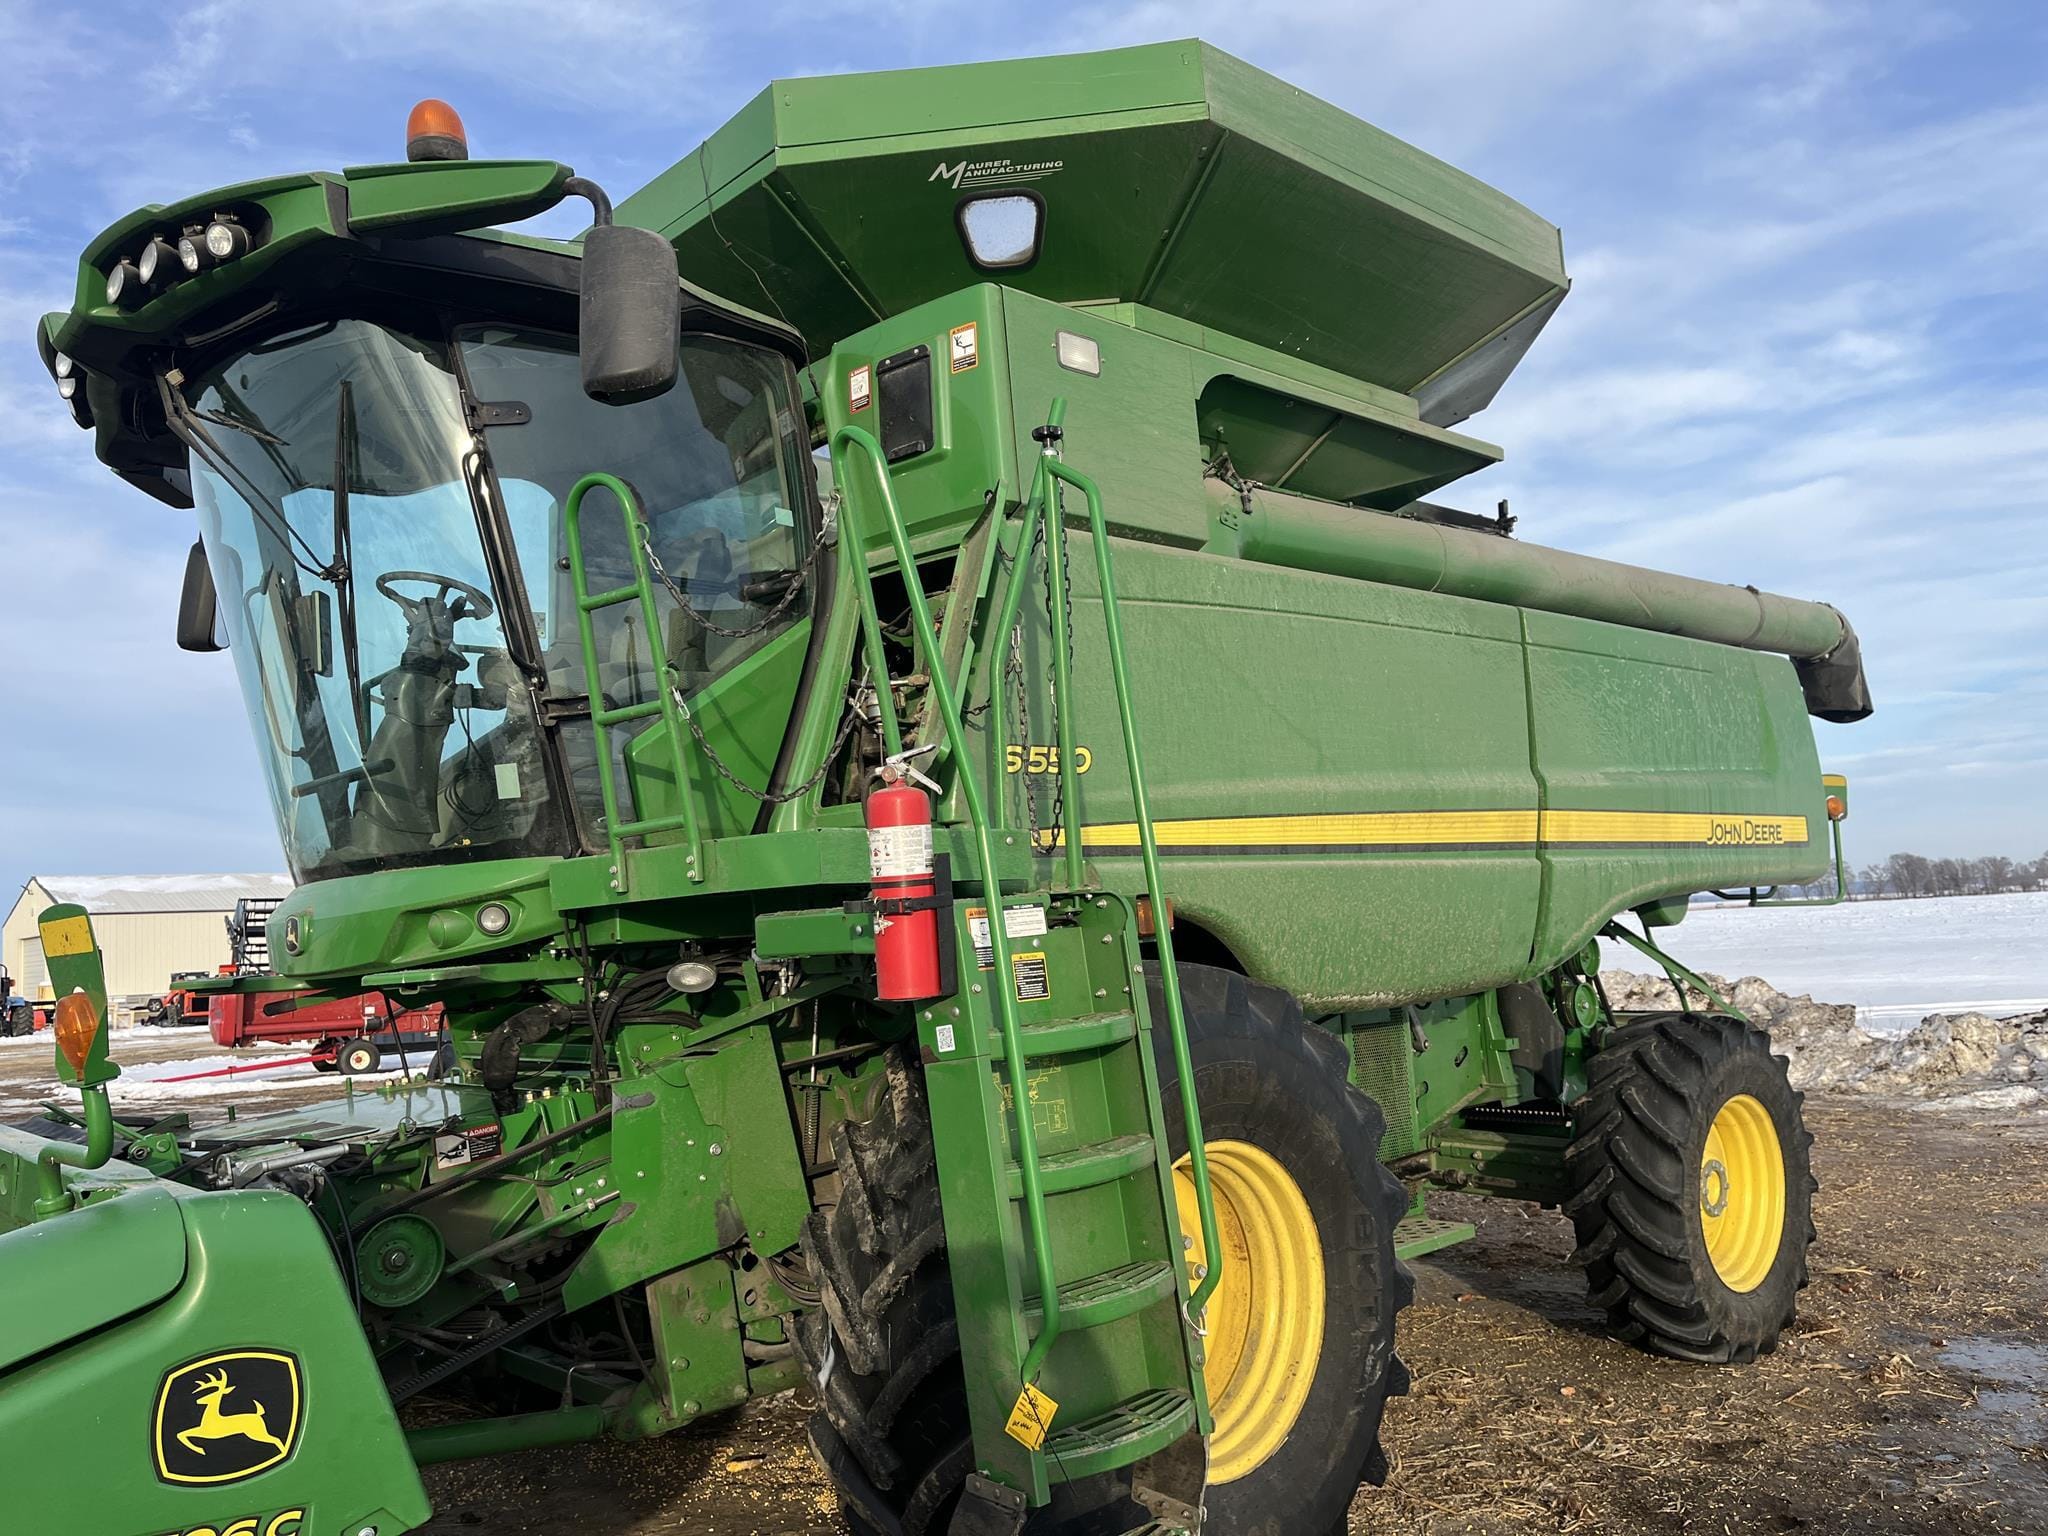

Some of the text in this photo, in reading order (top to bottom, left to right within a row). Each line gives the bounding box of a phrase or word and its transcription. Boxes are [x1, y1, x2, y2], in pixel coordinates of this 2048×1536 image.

[1707, 819, 1783, 842] JOHN DEERE
[474, 1125, 498, 1136] DANGER
